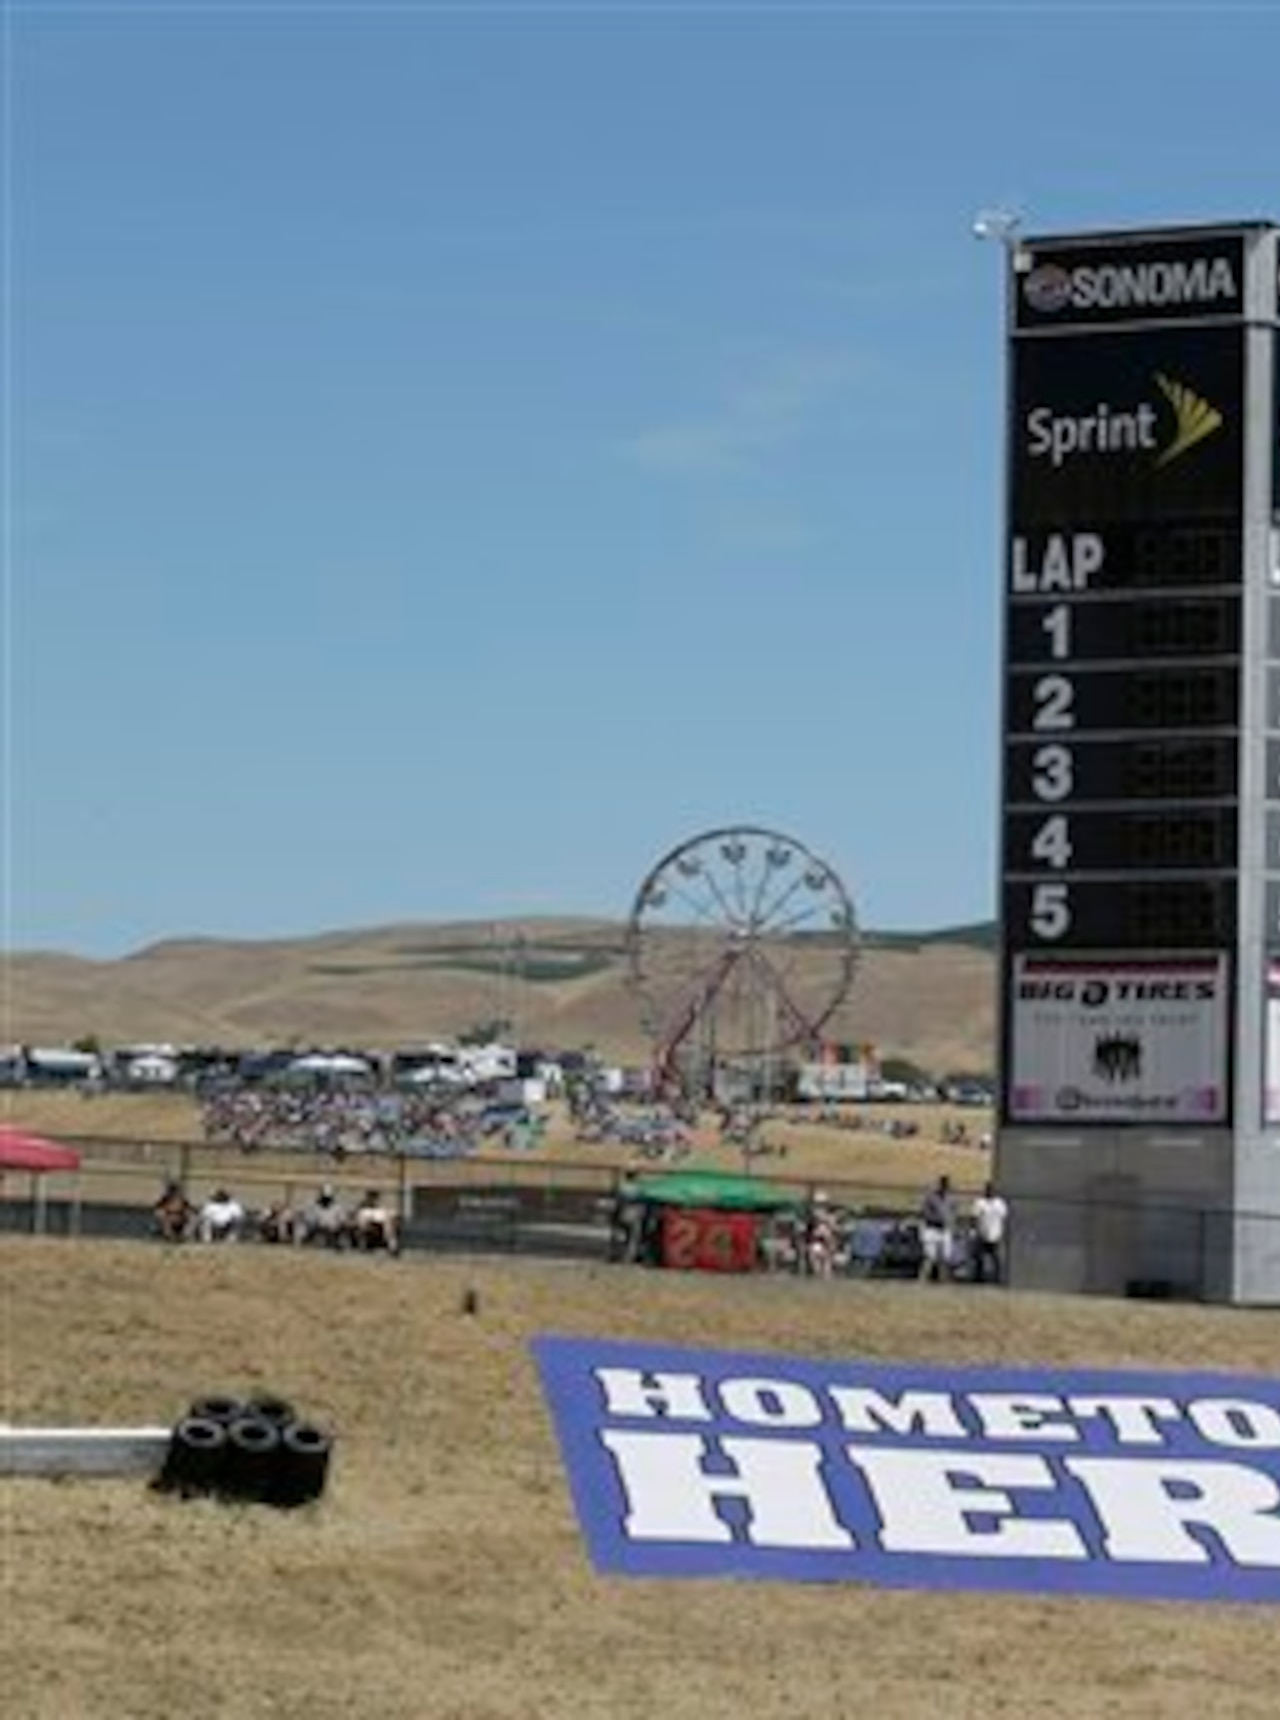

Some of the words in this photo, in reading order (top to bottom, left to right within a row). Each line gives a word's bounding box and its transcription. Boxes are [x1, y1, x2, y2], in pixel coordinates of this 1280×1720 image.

[1072, 257, 1236, 308] SONOMA
[1028, 404, 1156, 466] Sprint
[1013, 535, 1102, 592] LAP
[1043, 605, 1070, 657] 1
[1033, 675, 1074, 730] 2
[1033, 745, 1073, 800] 3
[1032, 816, 1072, 867] 4
[1031, 884, 1069, 939] 5
[1019, 981, 1075, 999] BIG
[1115, 981, 1215, 999] TIRES
